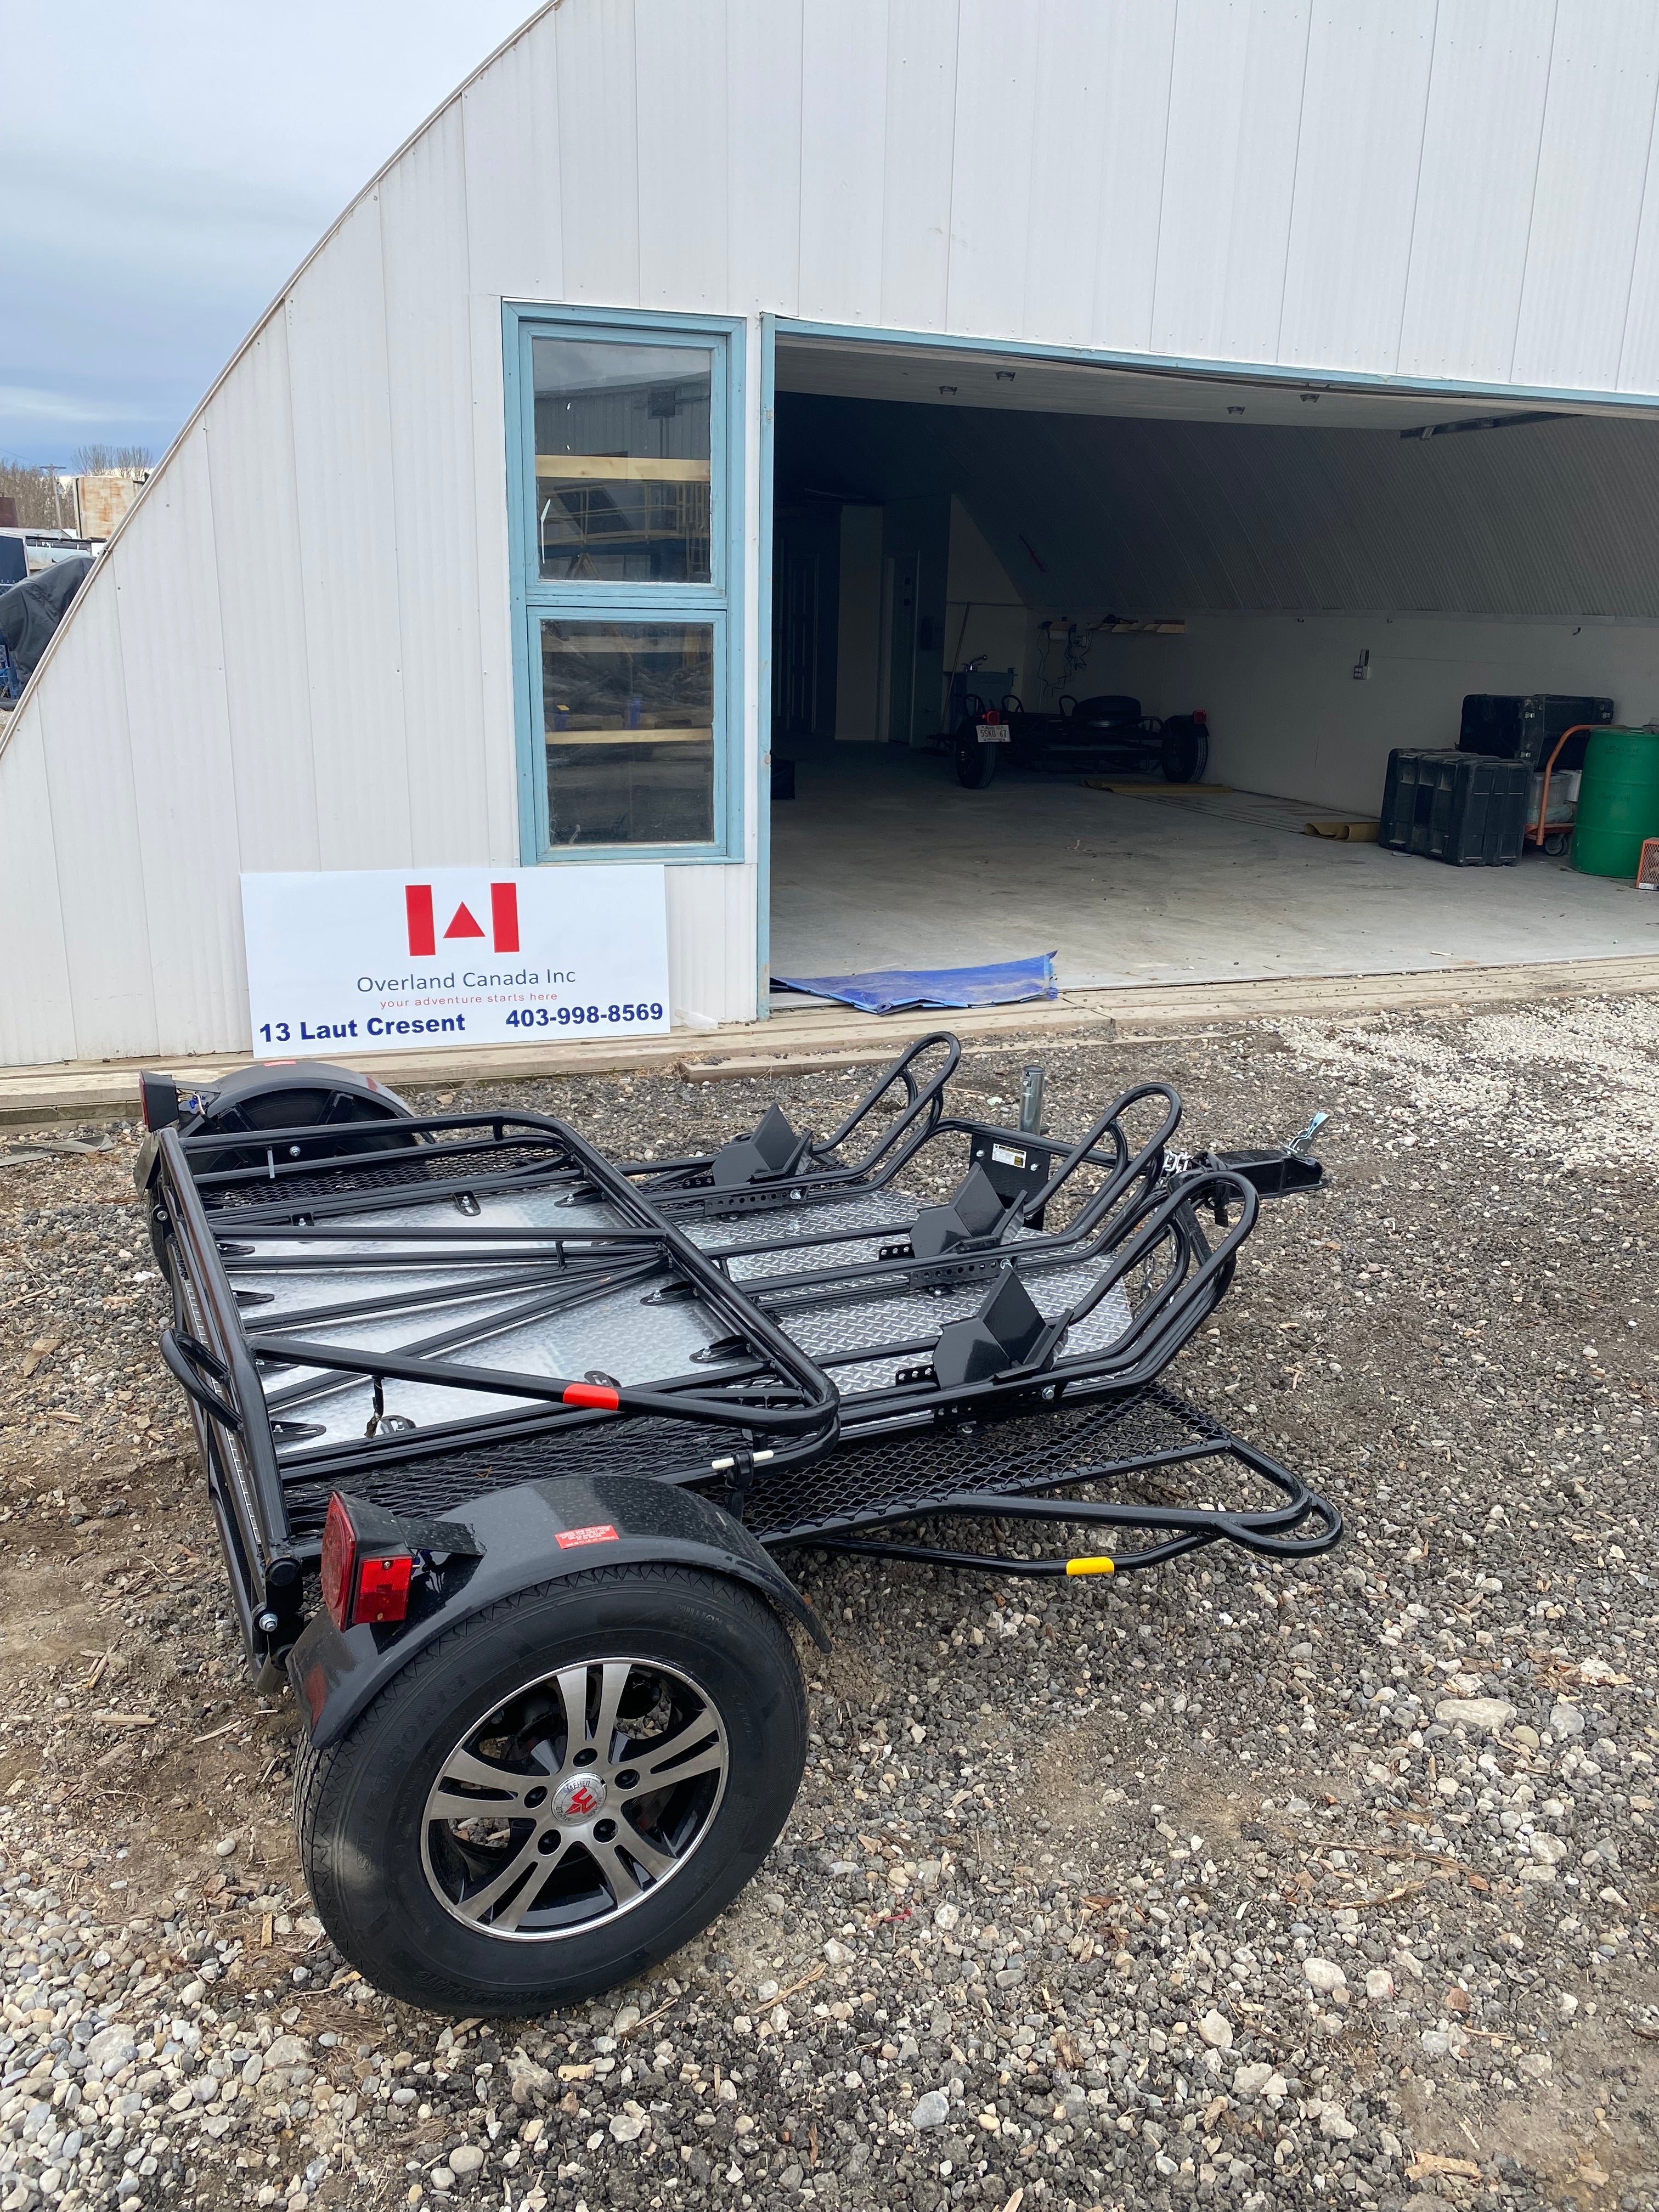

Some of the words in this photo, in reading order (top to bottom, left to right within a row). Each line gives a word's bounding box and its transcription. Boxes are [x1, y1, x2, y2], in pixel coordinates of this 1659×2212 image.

[357, 972, 454, 992] Overland
[463, 969, 538, 987] Canada
[548, 969, 575, 983] Inc
[380, 1000, 409, 1009] your
[415, 996, 481, 1006] adventure
[488, 994, 524, 1002] starts
[531, 993, 557, 1001] here
[506, 1003, 663, 1027] 403-998-8569
[260, 1023, 290, 1042] 13
[300, 1019, 358, 1040] Laut
[367, 1013, 465, 1036] Cresent
[675, 1604, 723, 1628] MILLION
